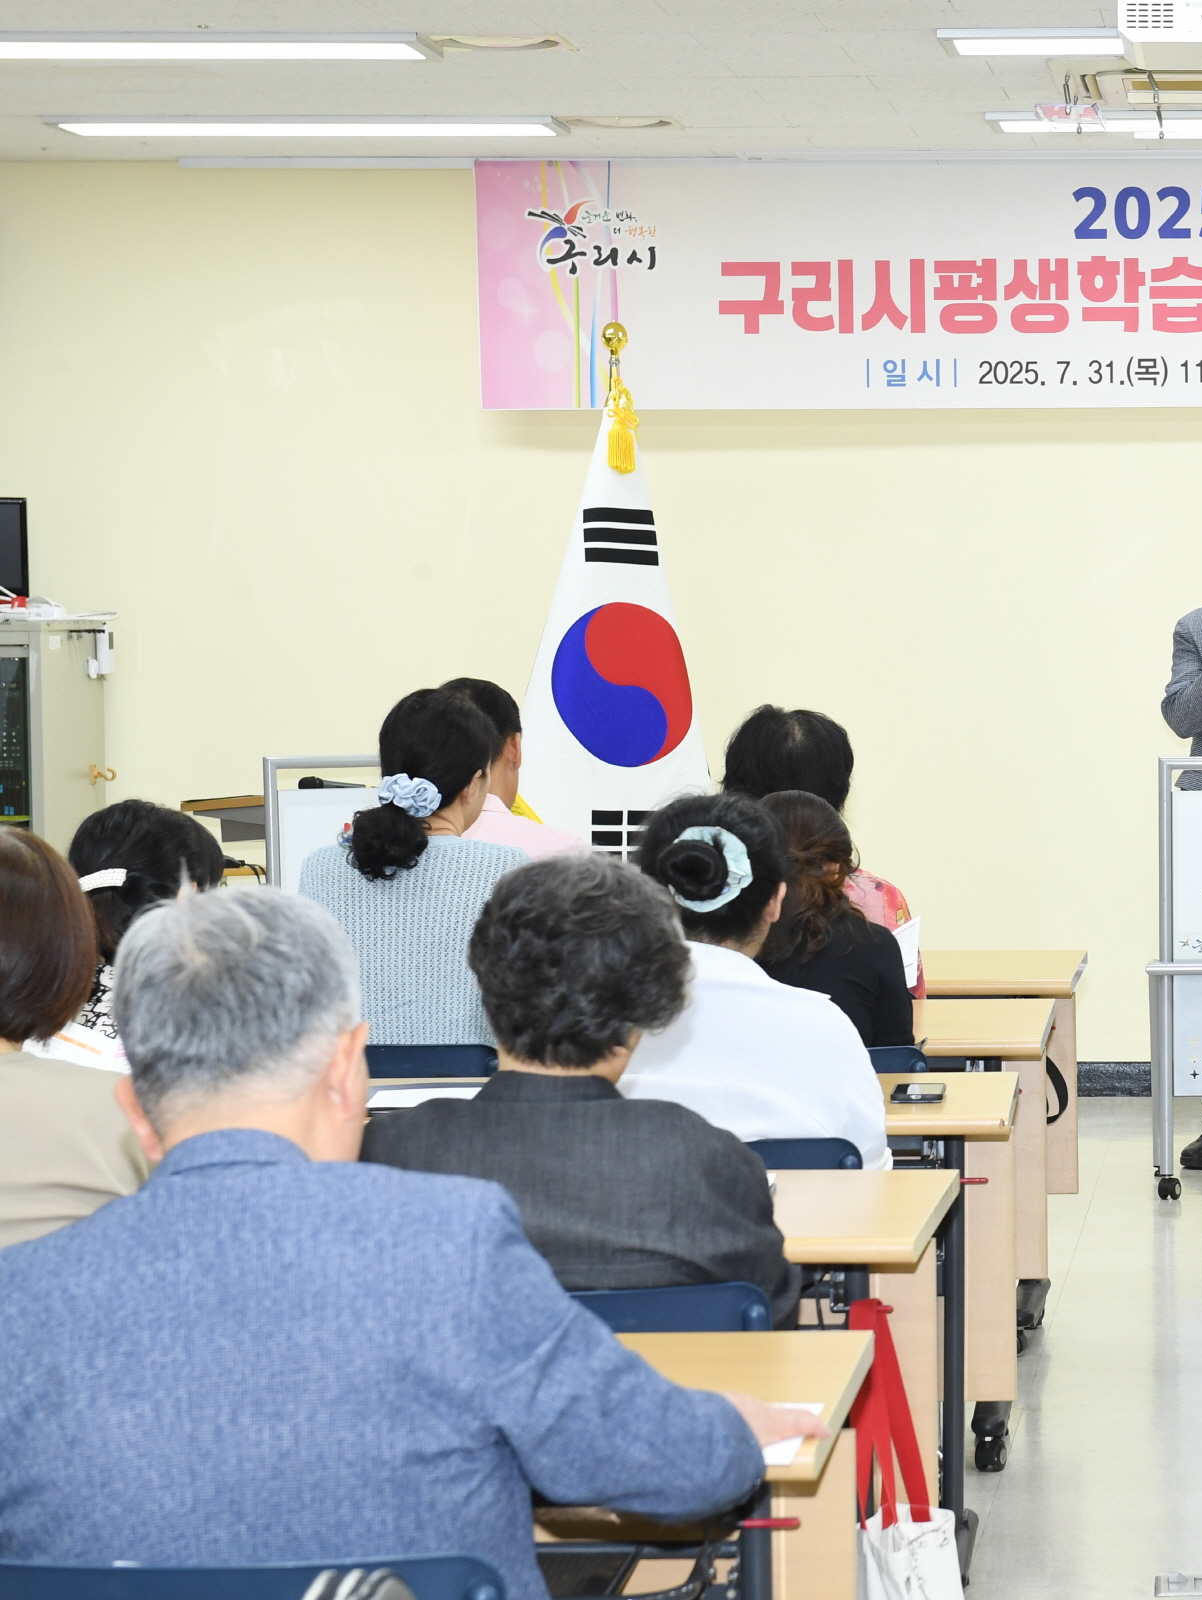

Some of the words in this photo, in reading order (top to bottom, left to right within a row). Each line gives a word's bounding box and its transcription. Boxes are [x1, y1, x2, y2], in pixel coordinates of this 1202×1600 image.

[624, 225, 658, 240] 행복한
[546, 238, 657, 275] 구리시
[978, 360, 1046, 387] 2025.
[1056, 360, 1078, 387] 7.
[1087, 355, 1169, 388] 31.(목)
